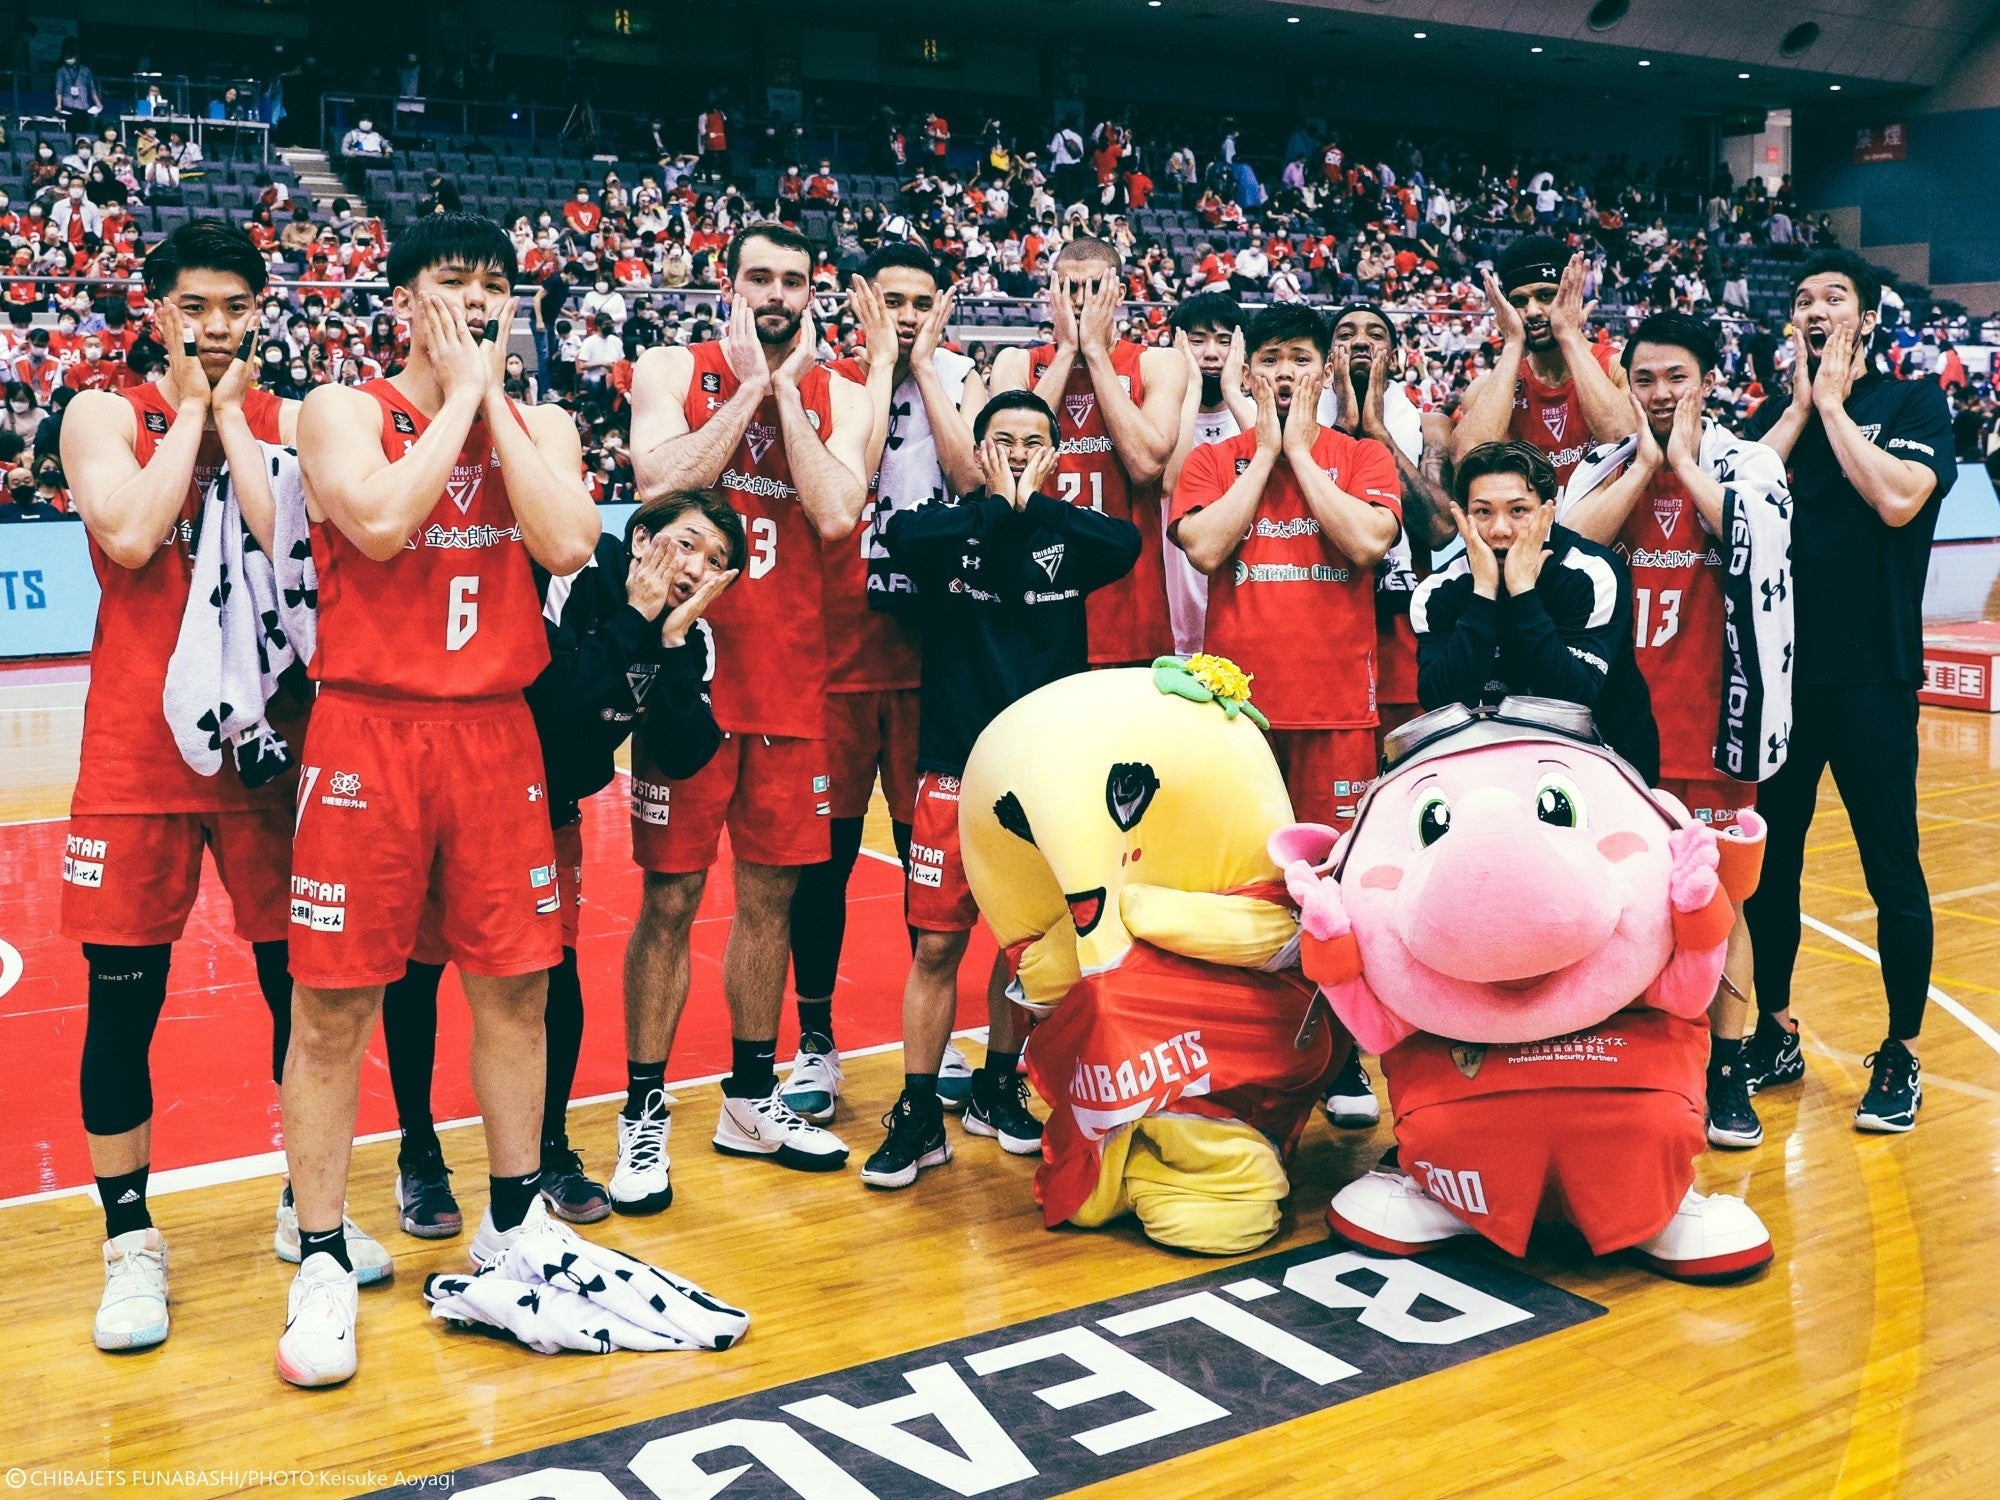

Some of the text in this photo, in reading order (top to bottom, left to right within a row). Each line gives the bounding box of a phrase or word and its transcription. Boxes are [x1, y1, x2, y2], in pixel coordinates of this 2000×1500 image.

[1057, 472, 1104, 514] 21
[1032, 544, 1064, 560] CHIBAJETS
[1632, 548, 1722, 568] 金太郎ホーム
[1250, 564, 1349, 582] Sateraito Office
[445, 575, 480, 651] 6
[1635, 588, 1683, 648] 13
[291, 875, 347, 903] TIPSTAR
[1508, 1053, 1619, 1064] Professional Security Partners
